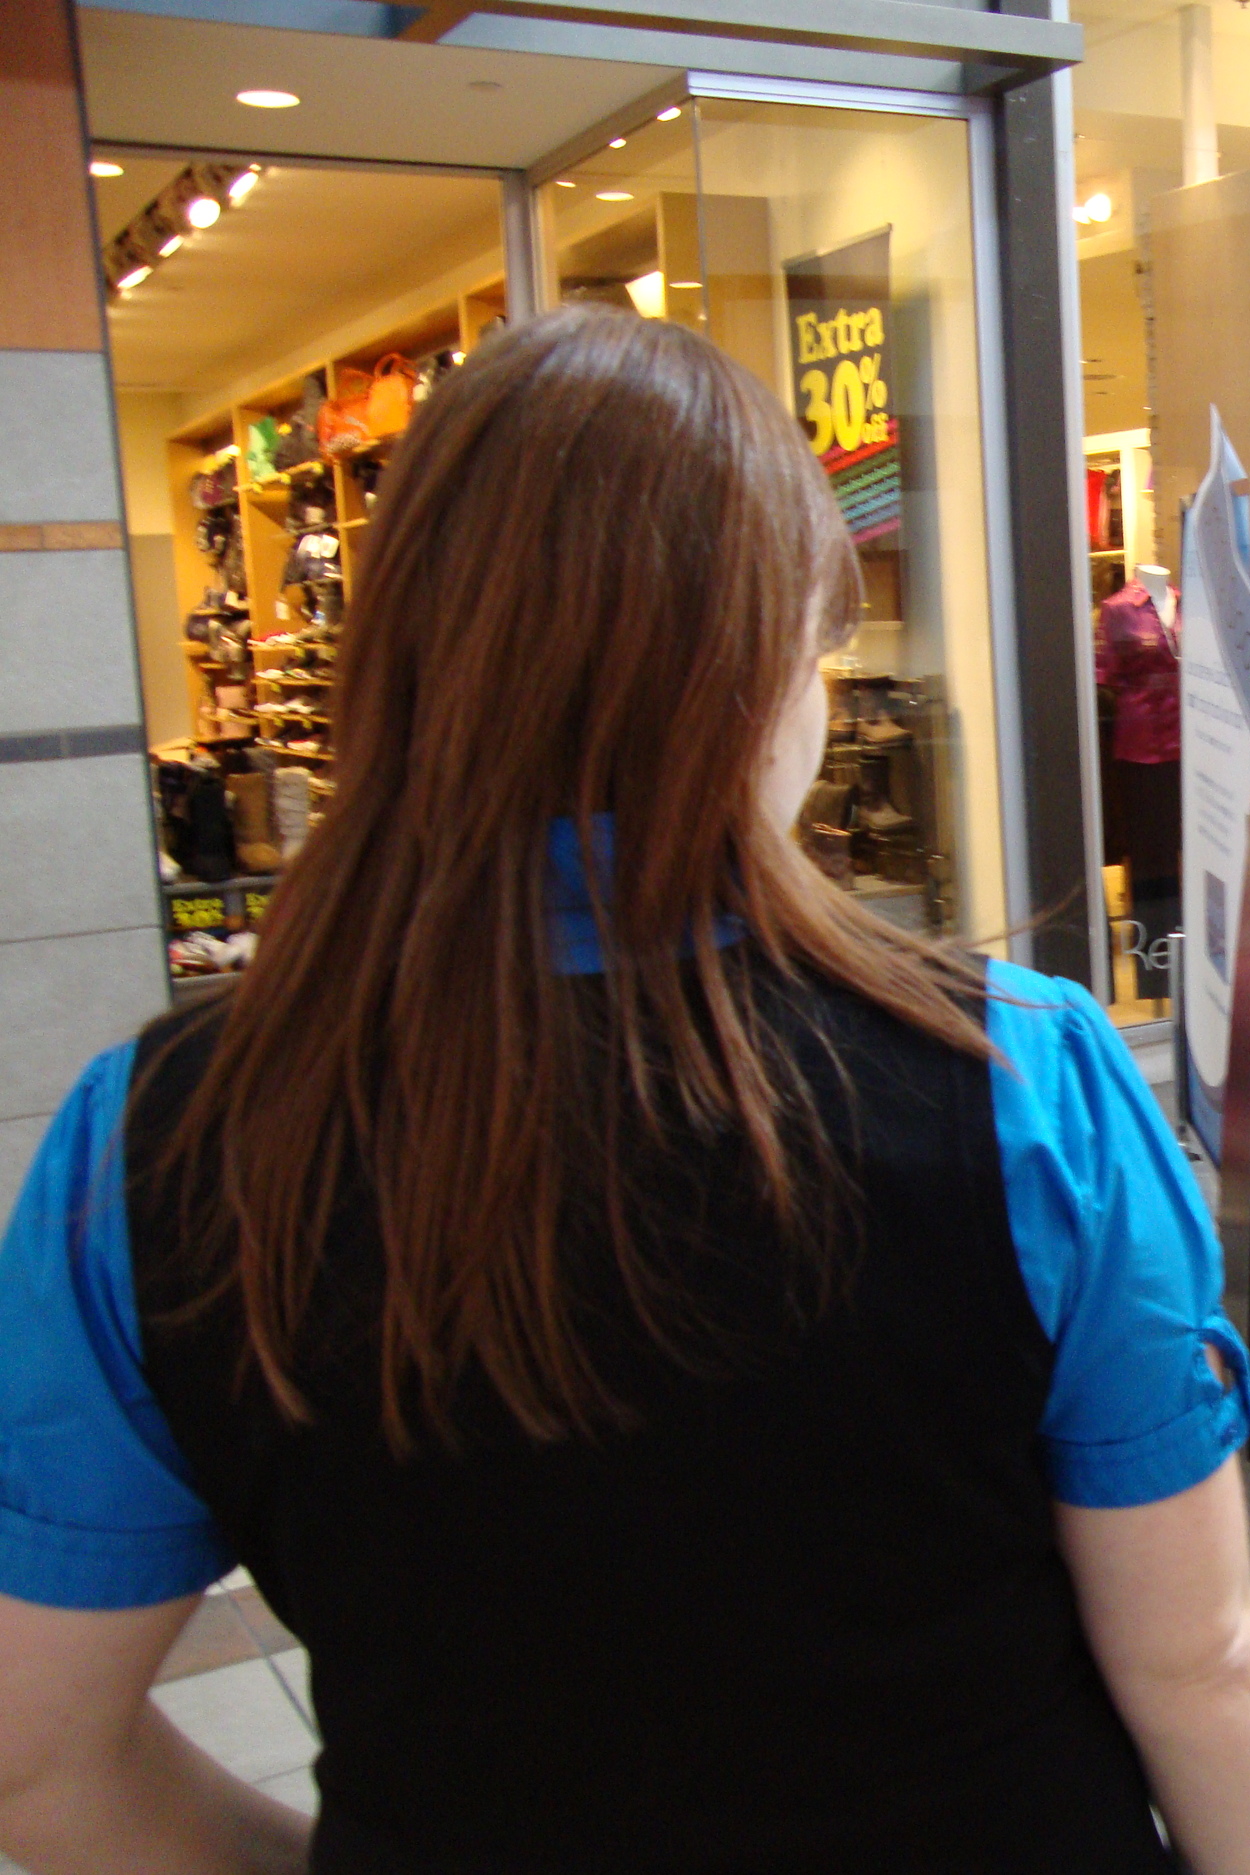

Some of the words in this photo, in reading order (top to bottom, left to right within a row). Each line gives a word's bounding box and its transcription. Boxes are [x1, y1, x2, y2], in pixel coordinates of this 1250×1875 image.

[796, 307, 885, 363] Extra
[800, 353, 888, 456] 30%
[1119, 919, 1183, 971] Re
